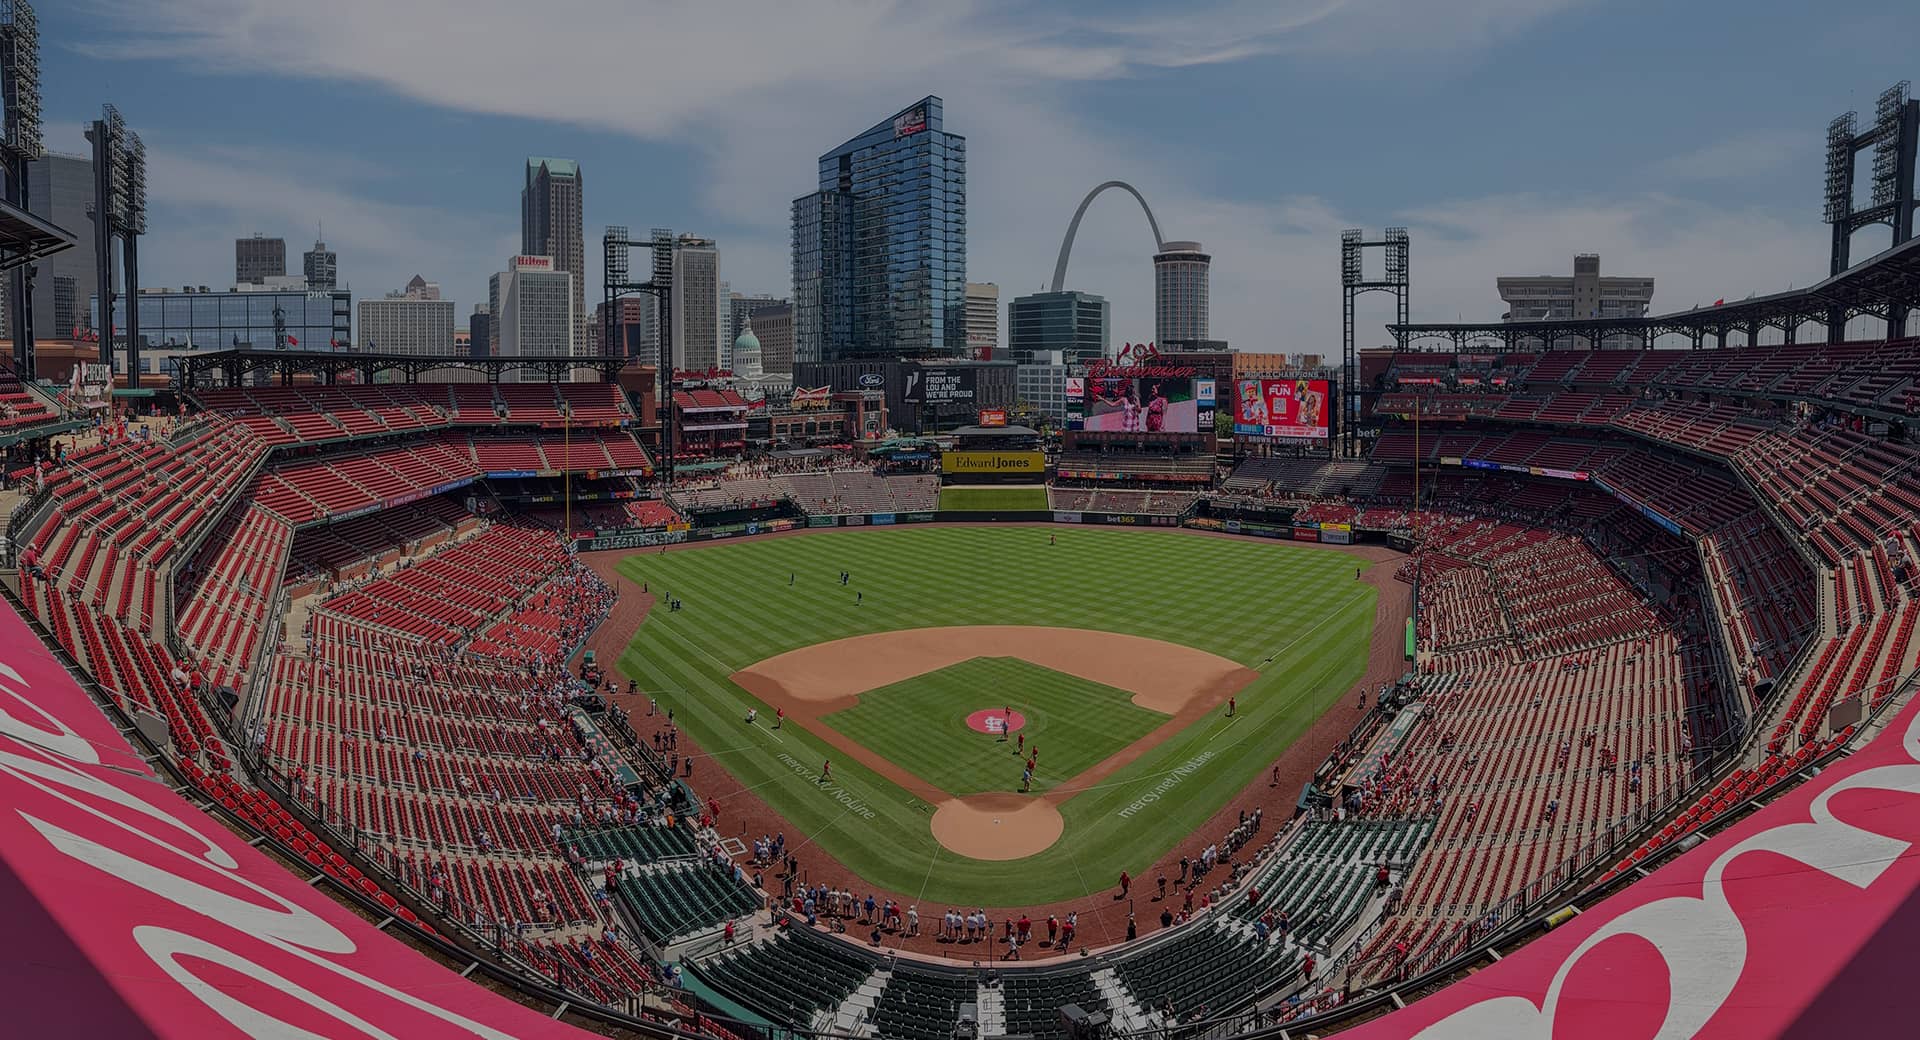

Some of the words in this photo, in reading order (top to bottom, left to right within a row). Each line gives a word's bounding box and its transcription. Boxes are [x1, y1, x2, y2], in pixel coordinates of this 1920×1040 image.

[518, 256, 548, 266] Hilton
[307, 290, 331, 301] pwc
[1084, 359, 1196, 378] Budweiser
[864, 374, 880, 384] Ford
[926, 376, 946, 384] FROM
[941, 383, 956, 391] AND
[1269, 387, 1290, 396] FUN
[926, 391, 948, 399] WE'RE
[949, 390, 973, 398] PROUD
[1199, 410, 1214, 421] stl
[956, 457, 995, 468] Edward
[996, 457, 1030, 469] Jones
[1107, 515, 1136, 523] bet365
[777, 752, 876, 820] mercy.net/NoLine
[1118, 751, 1215, 818] mercy.net/NoLine
